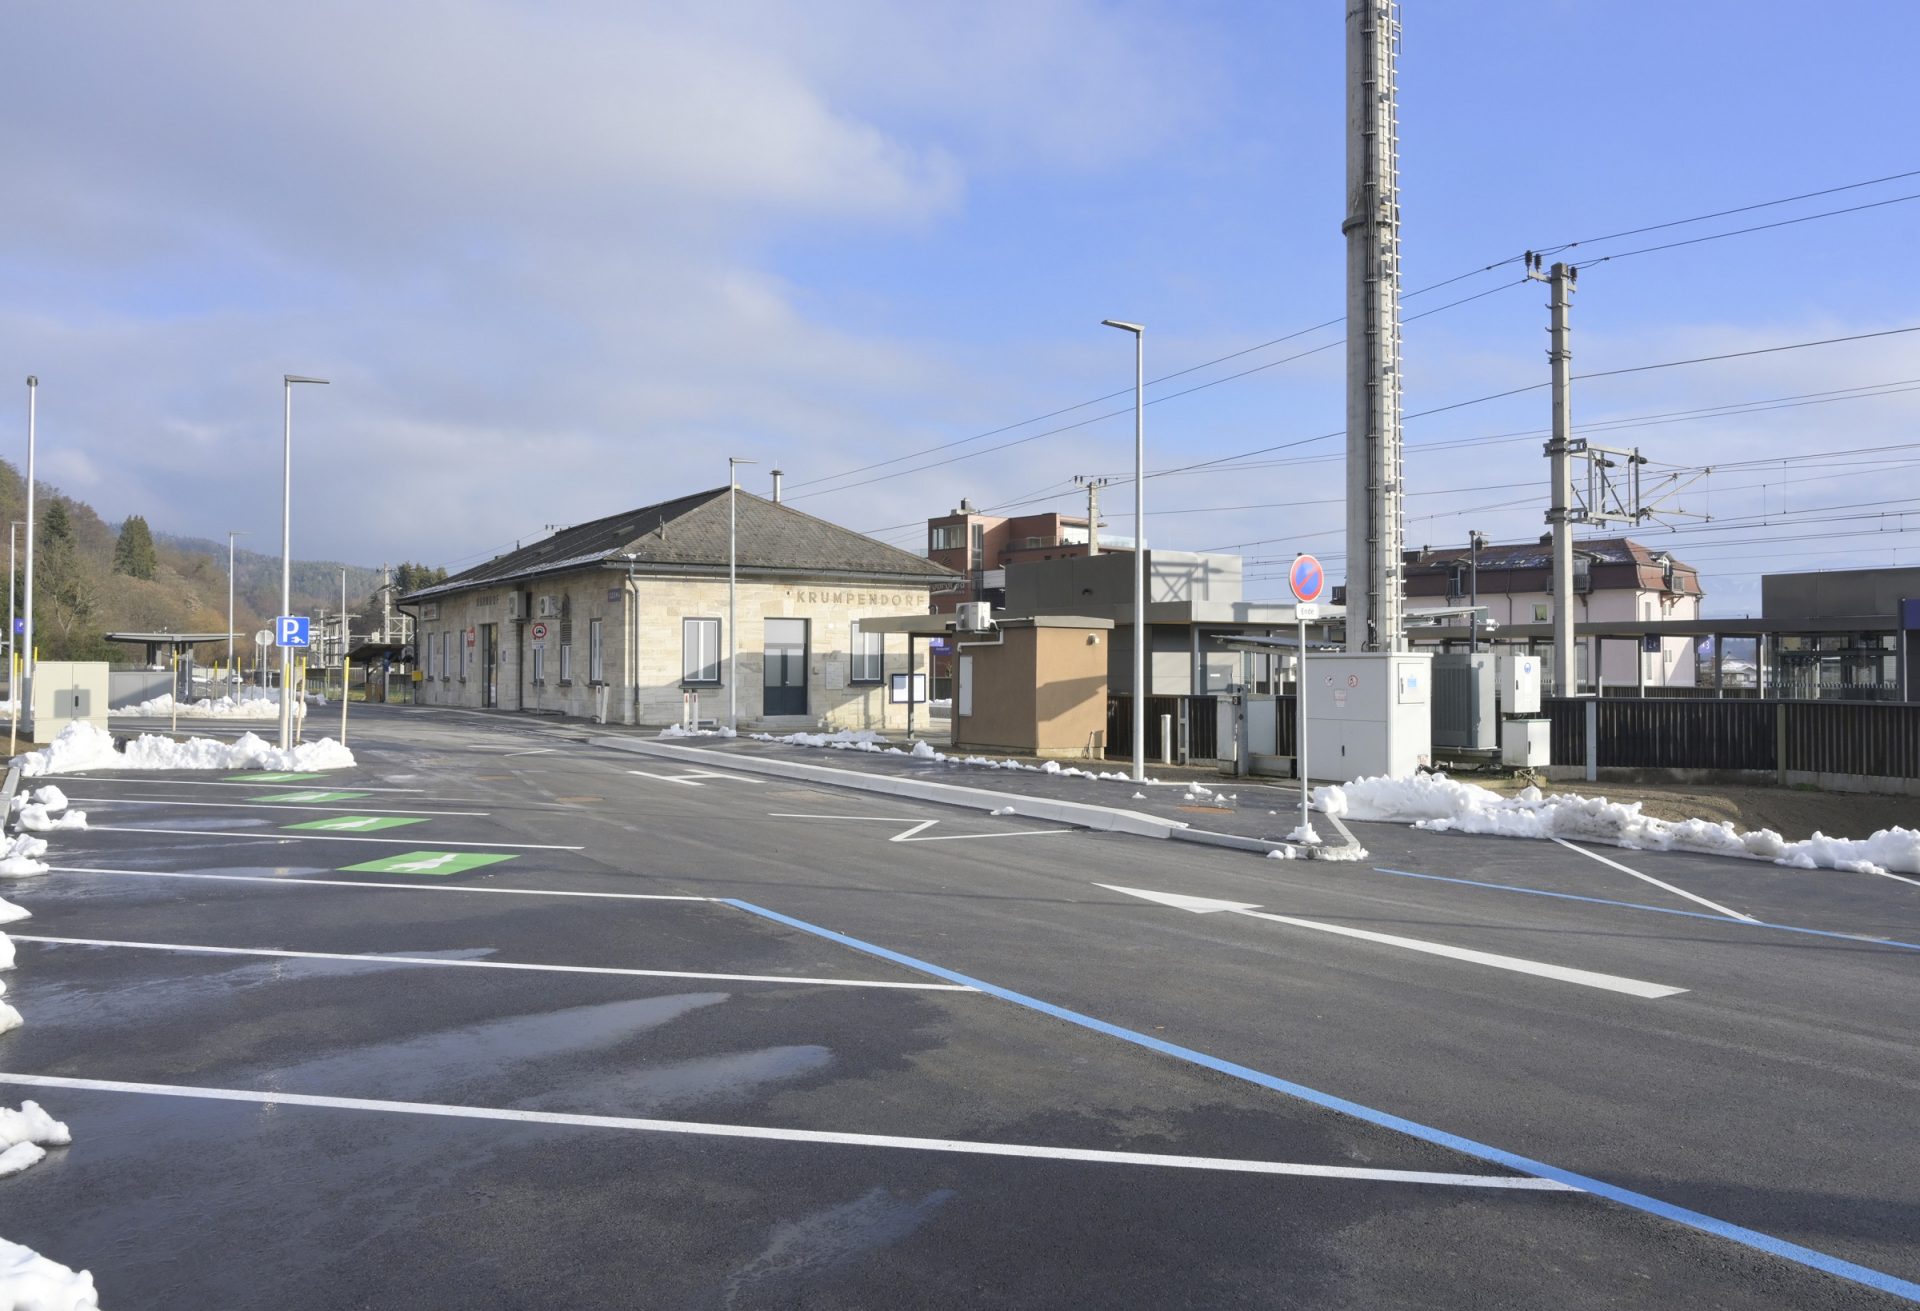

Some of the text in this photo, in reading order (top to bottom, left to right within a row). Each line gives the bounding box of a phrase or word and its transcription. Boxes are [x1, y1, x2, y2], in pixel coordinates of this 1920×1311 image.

[796, 591, 925, 606] KRUMPENDORF
[1301, 607, 1314, 616] Ende
[282, 619, 299, 642] P
